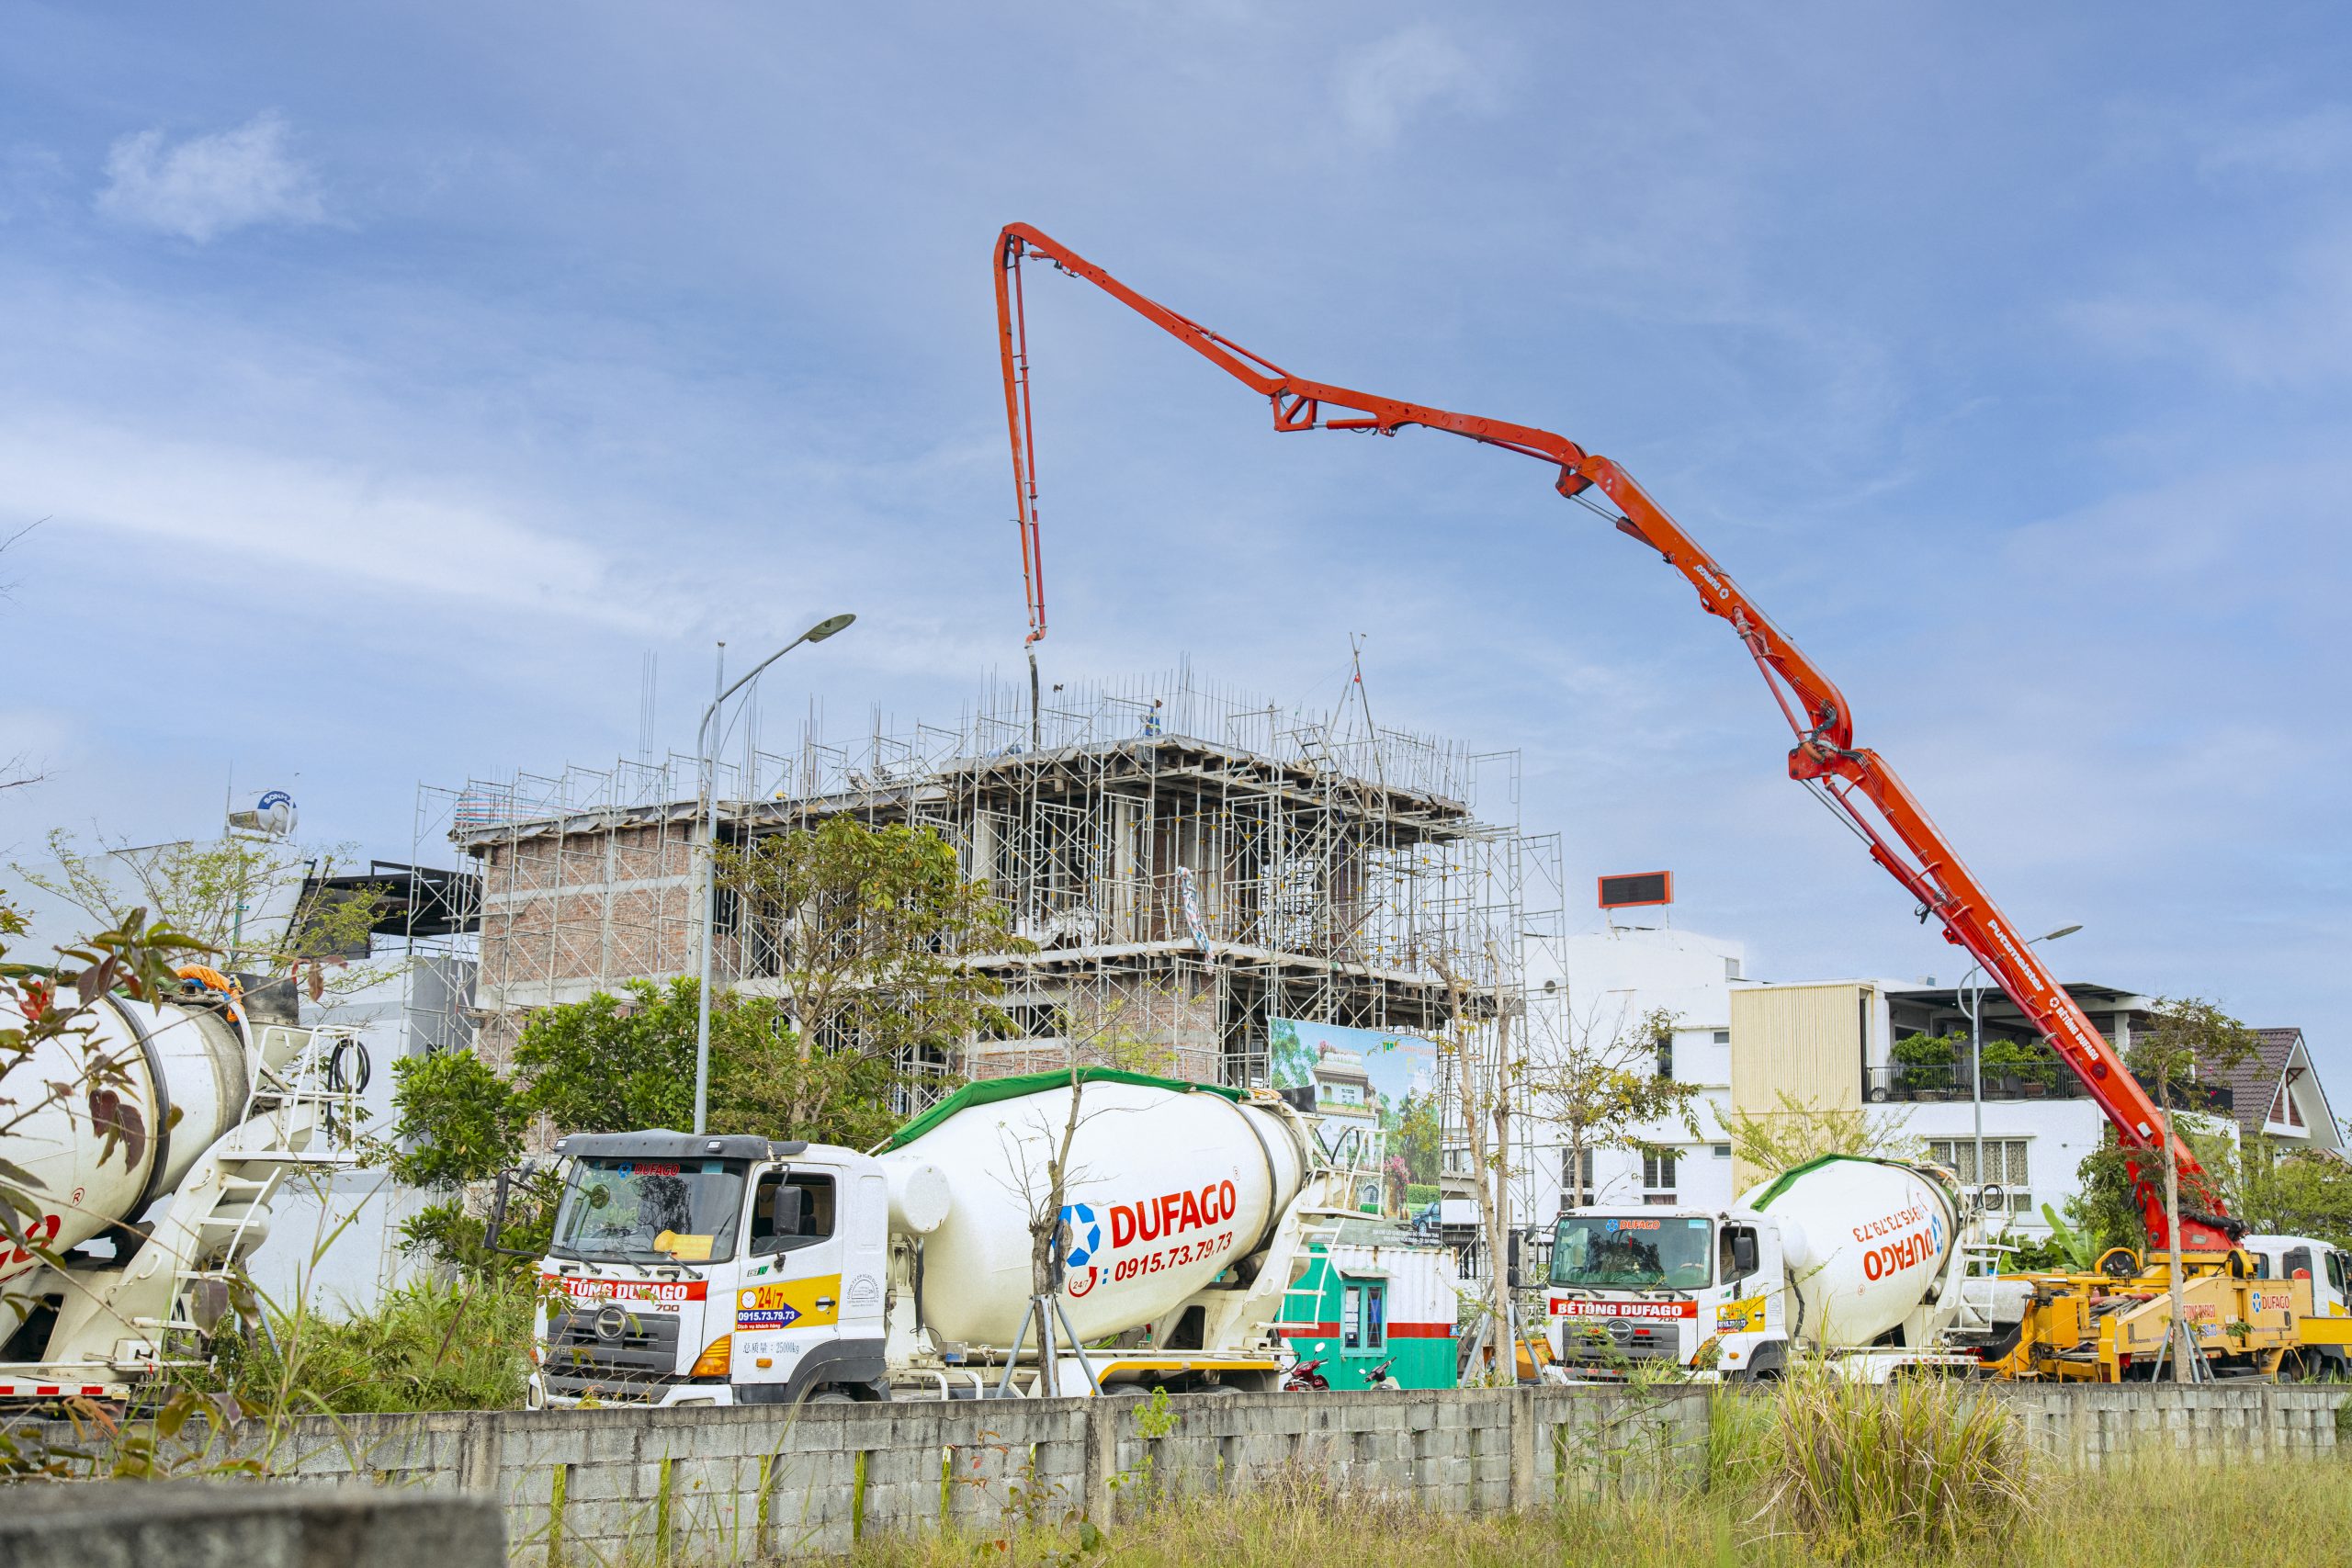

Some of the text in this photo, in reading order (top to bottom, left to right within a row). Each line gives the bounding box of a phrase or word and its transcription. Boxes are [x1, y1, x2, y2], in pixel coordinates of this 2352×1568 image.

[1987, 919, 2044, 992] Putzmeister
[2075, 1032, 2099, 1061] DUFAGO
[634, 1163, 680, 1176] DUFAGO
[1110, 1179, 1236, 1248] DUFAGO
[1620, 1220, 1660, 1230] DUFAGO
[1114, 1231, 1233, 1281] 0915.73.79.73
[1864, 1228, 1934, 1280] DUFAGO
[758, 1287, 783, 1309] 24/7
[1557, 1302, 1682, 1316] BÊTÔNG DUFAGO
[2262, 1295, 2290, 1310] DUFAGO
[738, 1311, 795, 1321] 0915.73.79.73
